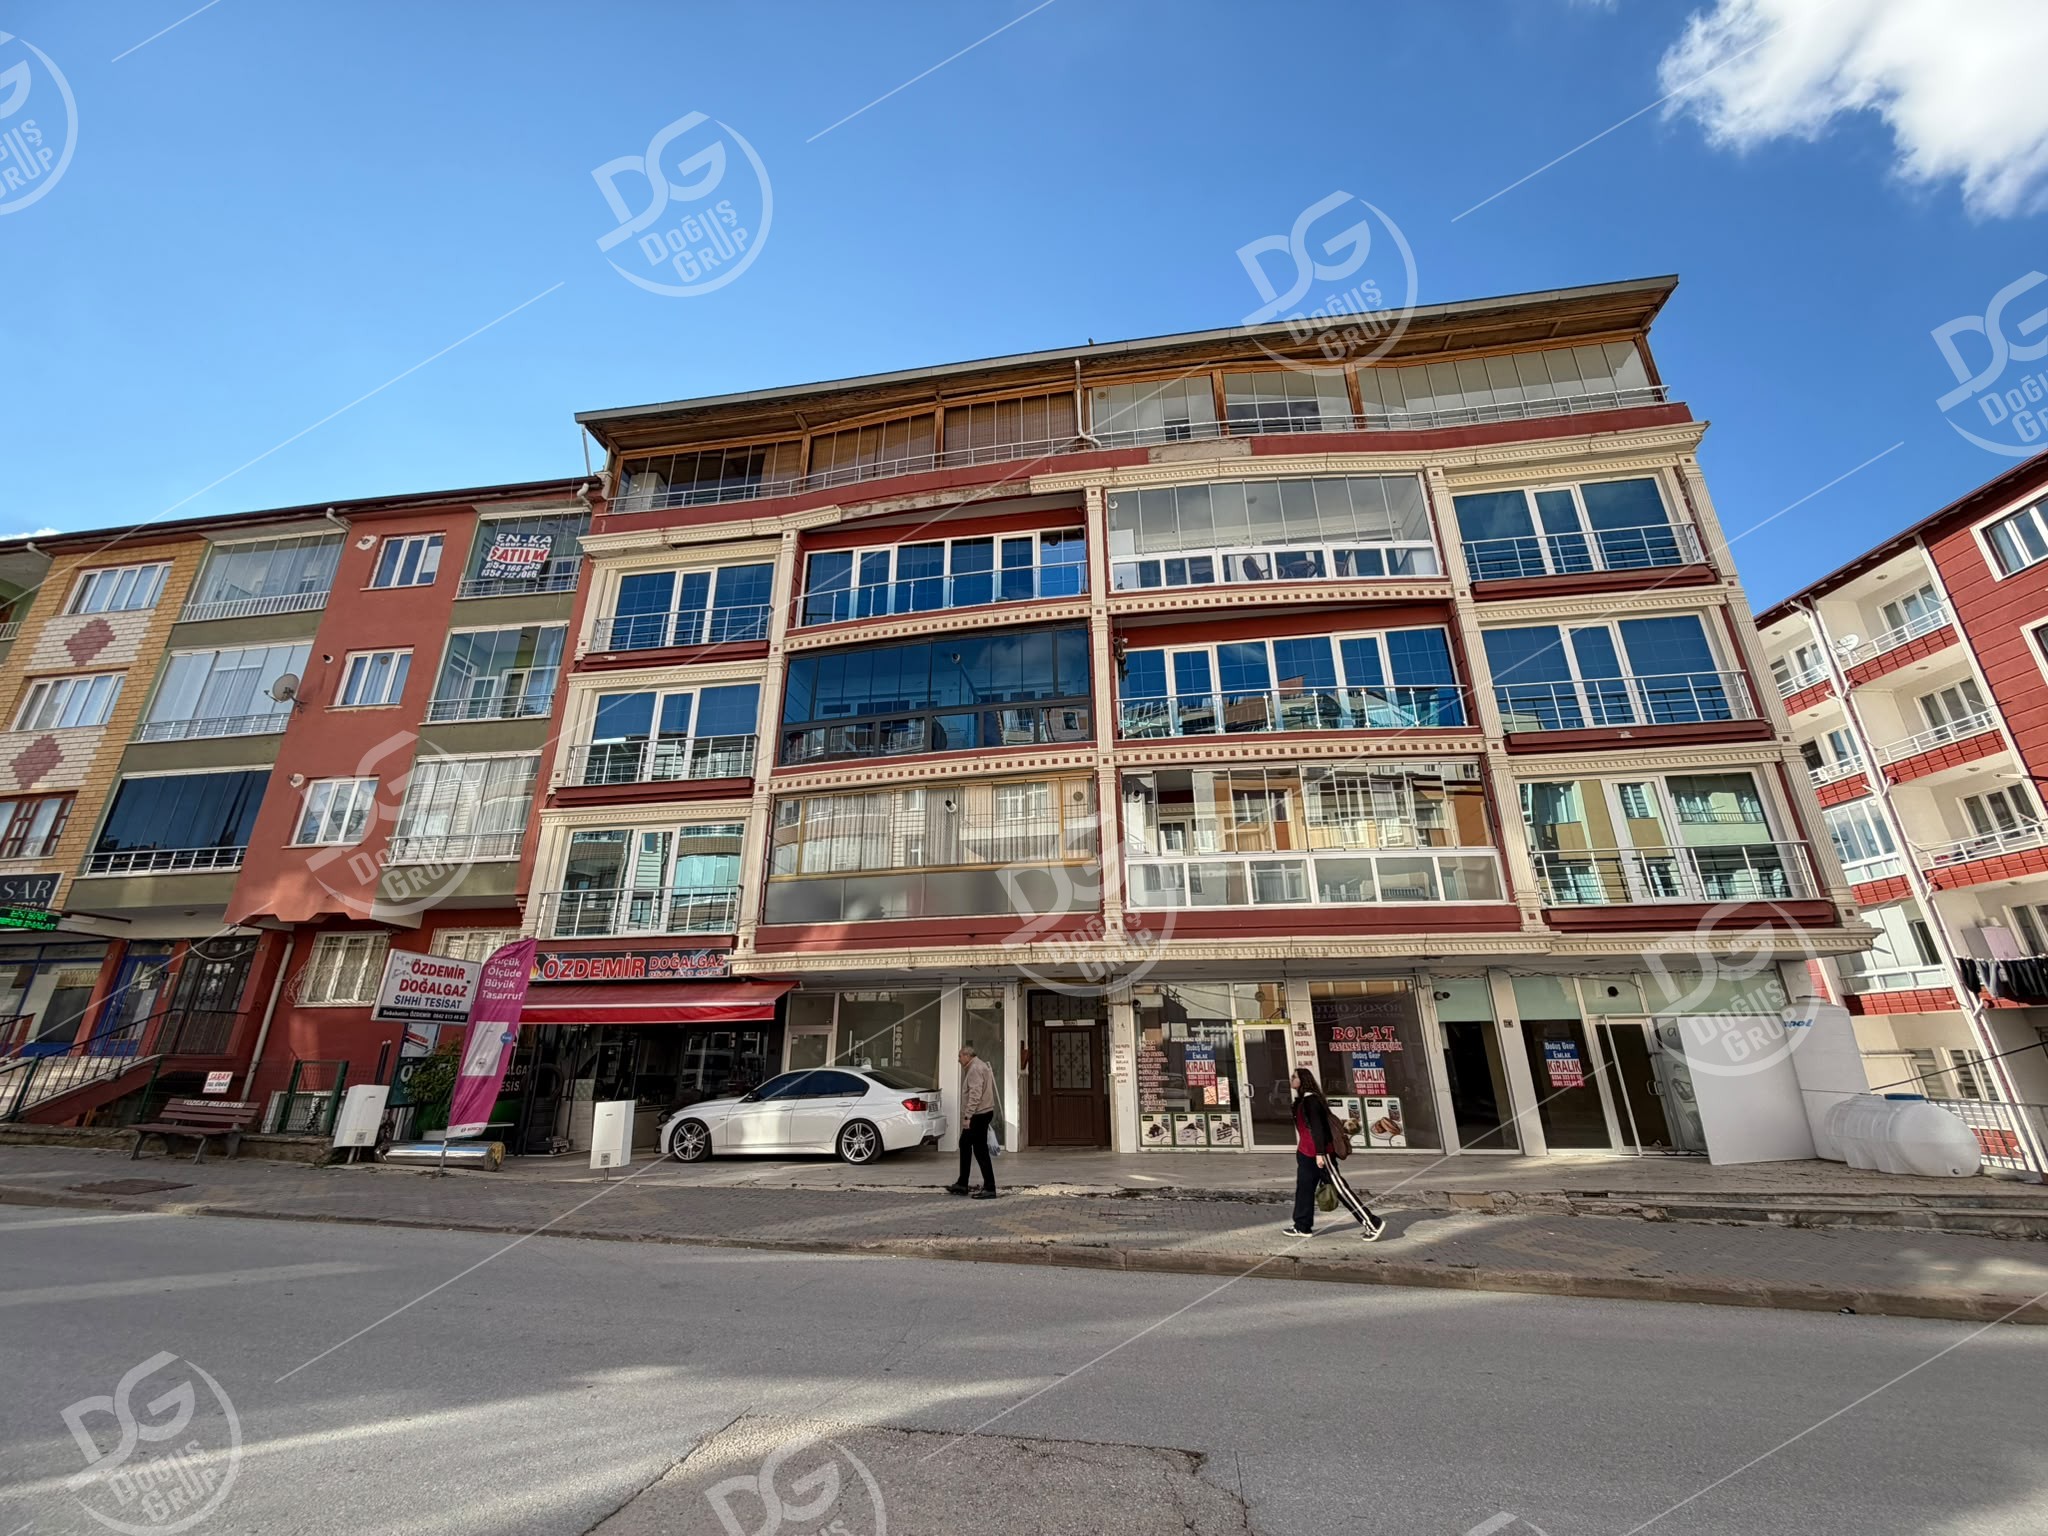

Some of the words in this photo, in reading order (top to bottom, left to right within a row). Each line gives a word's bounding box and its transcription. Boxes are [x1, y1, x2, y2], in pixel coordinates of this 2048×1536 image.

[497, 534, 552, 543] EN-KA
[411, 959, 466, 980] ÖZDEMİR
[487, 966, 522, 978] Ölçüde
[543, 953, 646, 980] ÖZDEMİR
[648, 952, 726, 970] DOĞALGAZ
[400, 976, 468, 997] DOĞALGAZ
[484, 978, 515, 989] Büyük
[482, 989, 524, 1001] Tasarruf
[425, 996, 463, 1009] TESİSAT
[1332, 1026, 1395, 1040] BOLAT
[1329, 1040, 1361, 1051] PASTANESİ
[1186, 1061, 1216, 1072] KİRALIK
[1547, 1060, 1582, 1072] KİRALIK
[1353, 1070, 1384, 1081] KİRALIK
